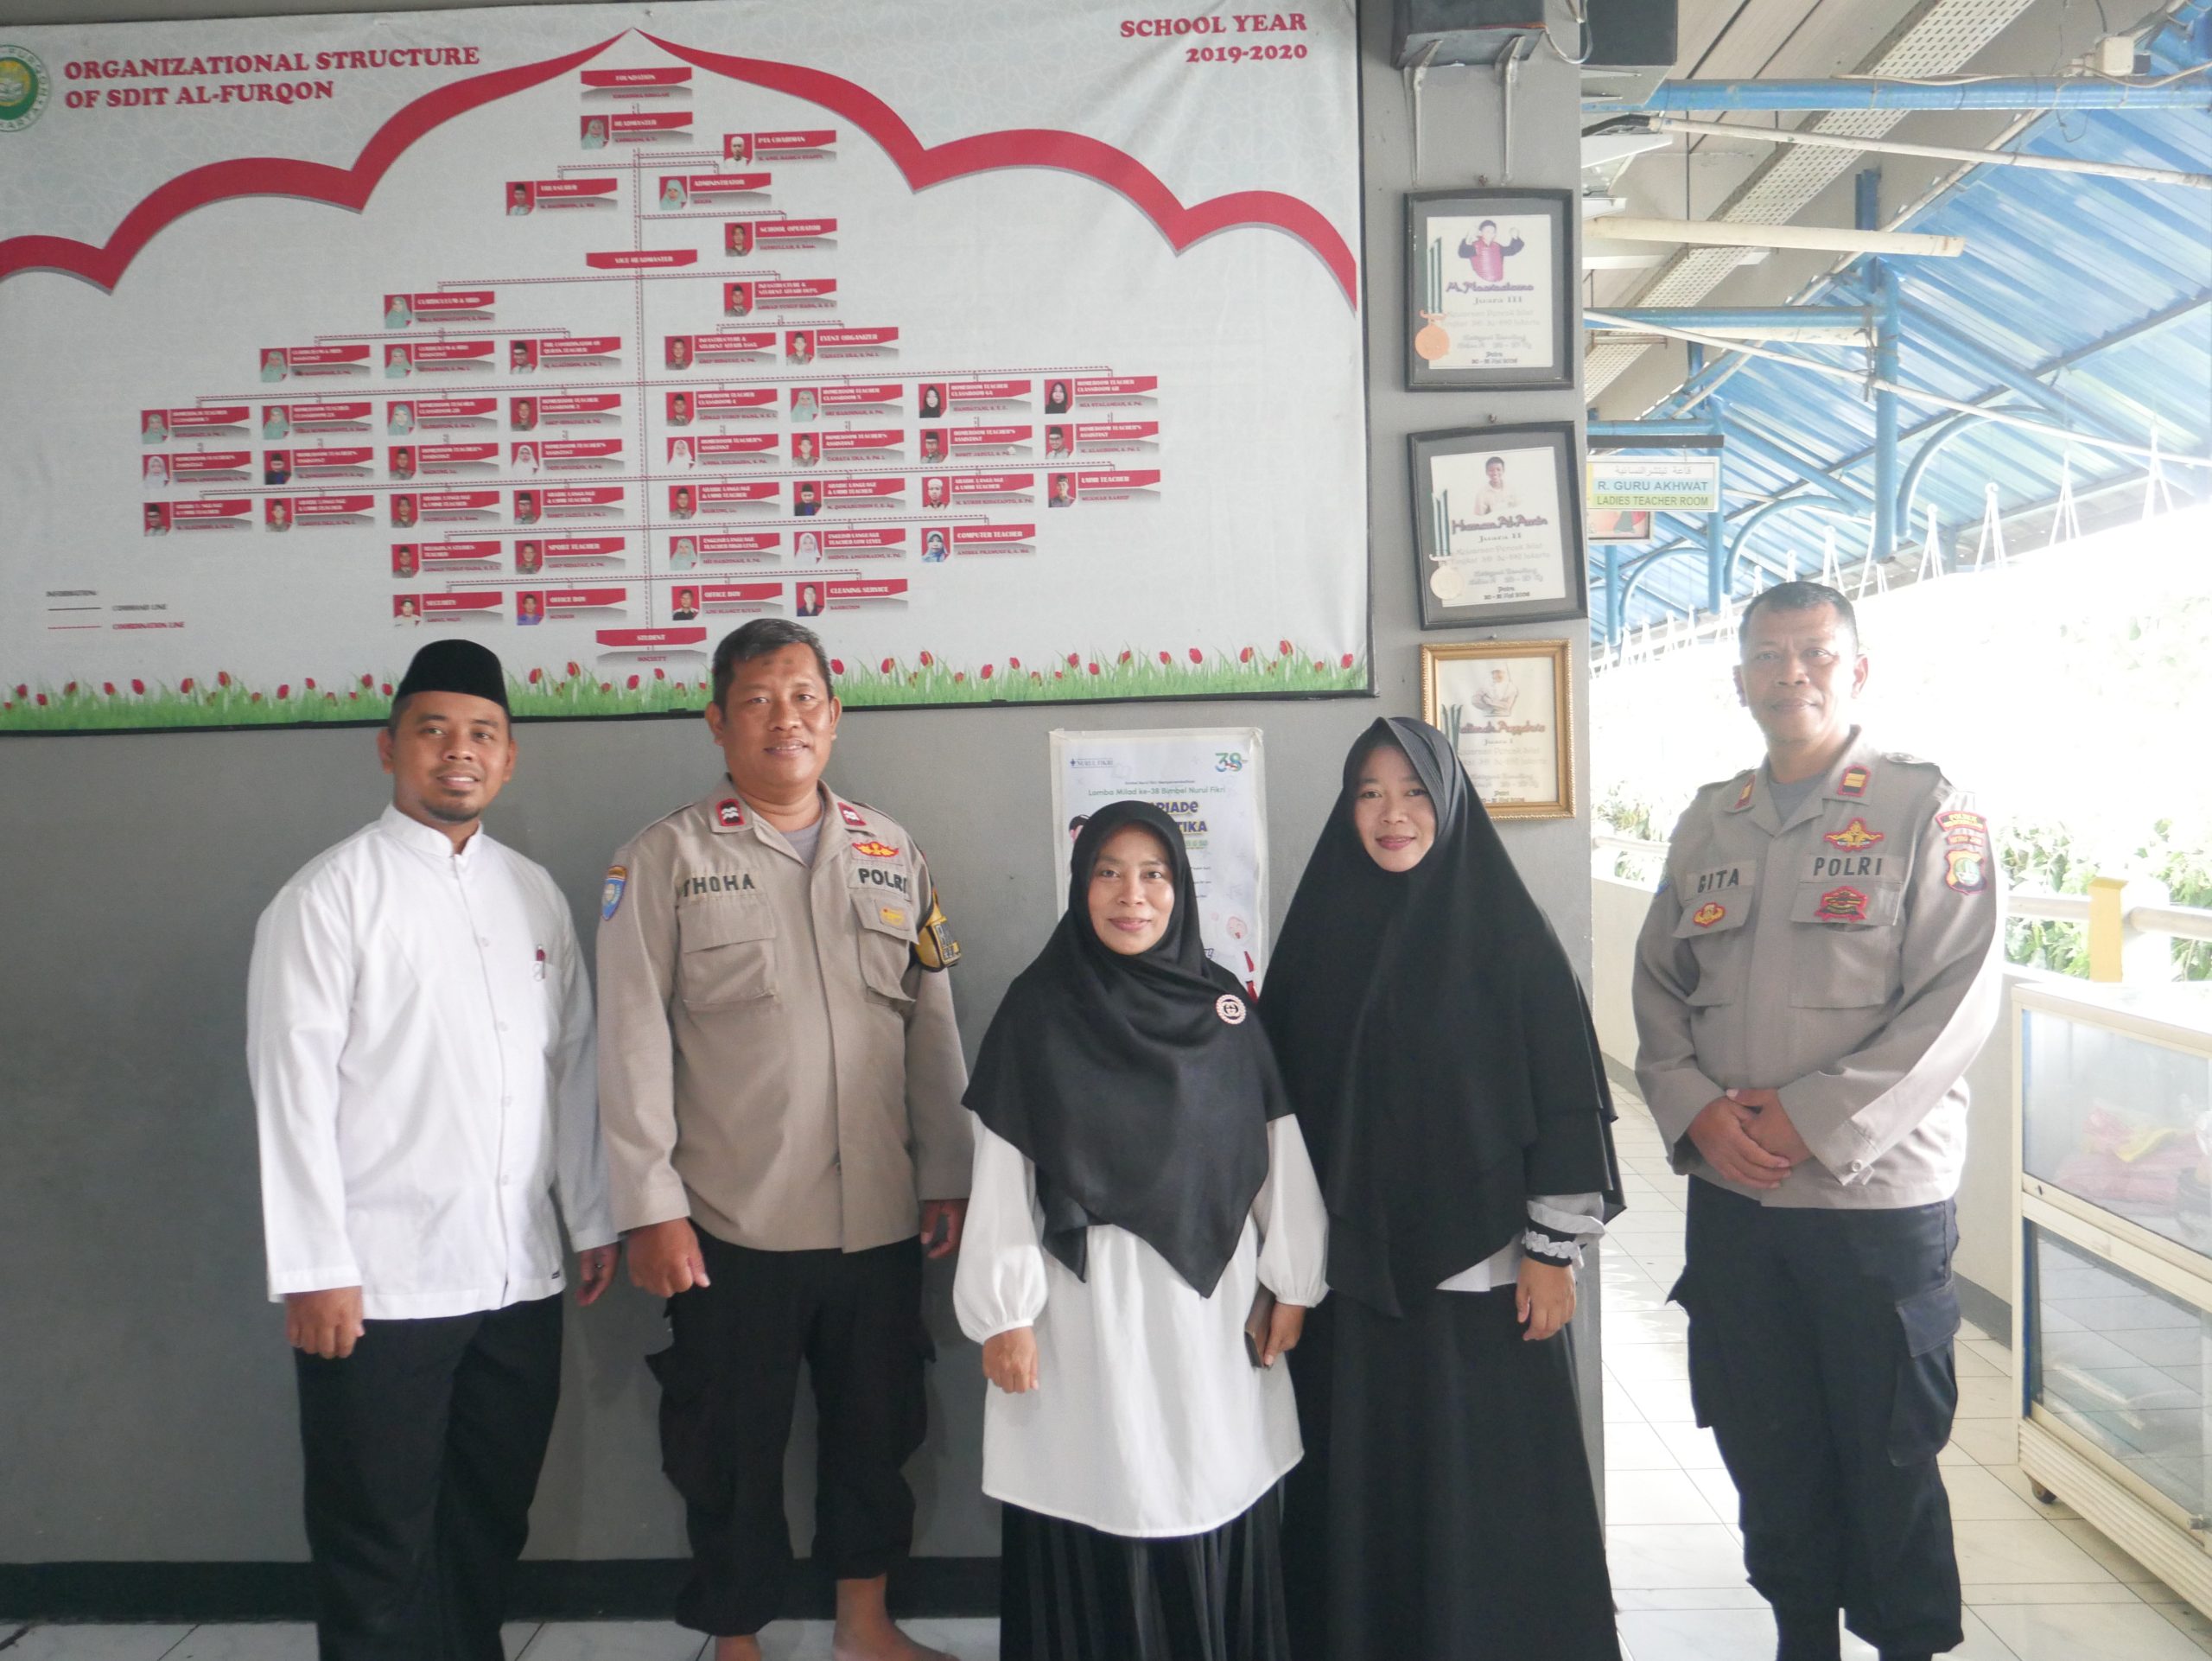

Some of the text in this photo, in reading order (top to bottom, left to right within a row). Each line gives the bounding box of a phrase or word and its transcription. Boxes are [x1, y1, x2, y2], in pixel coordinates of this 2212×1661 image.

[1120, 13, 1307, 37] SCHOOL YEAR
[64, 47, 480, 80] ORGANIZATIONAL STRUCTURE
[1185, 44, 1307, 63] 2019-2020
[65, 80, 334, 109] OF SDIT AL-FURQON
[1598, 480, 1708, 491] R. GURU AKHWAT
[1597, 496, 1709, 506] LADIES TEACHER ROOM
[1215, 752, 1243, 772] 38
[1116, 787, 1137, 796] Milad
[1139, 786, 1160, 795] ke-38
[1161, 786, 1186, 795] Bimbel
[1189, 786, 1209, 794] Nurul
[1210, 786, 1225, 794] Fikri
[1176, 820, 1208, 833] TIKA
[1813, 856, 1882, 876] POLRI
[858, 868, 907, 894] POLRI
